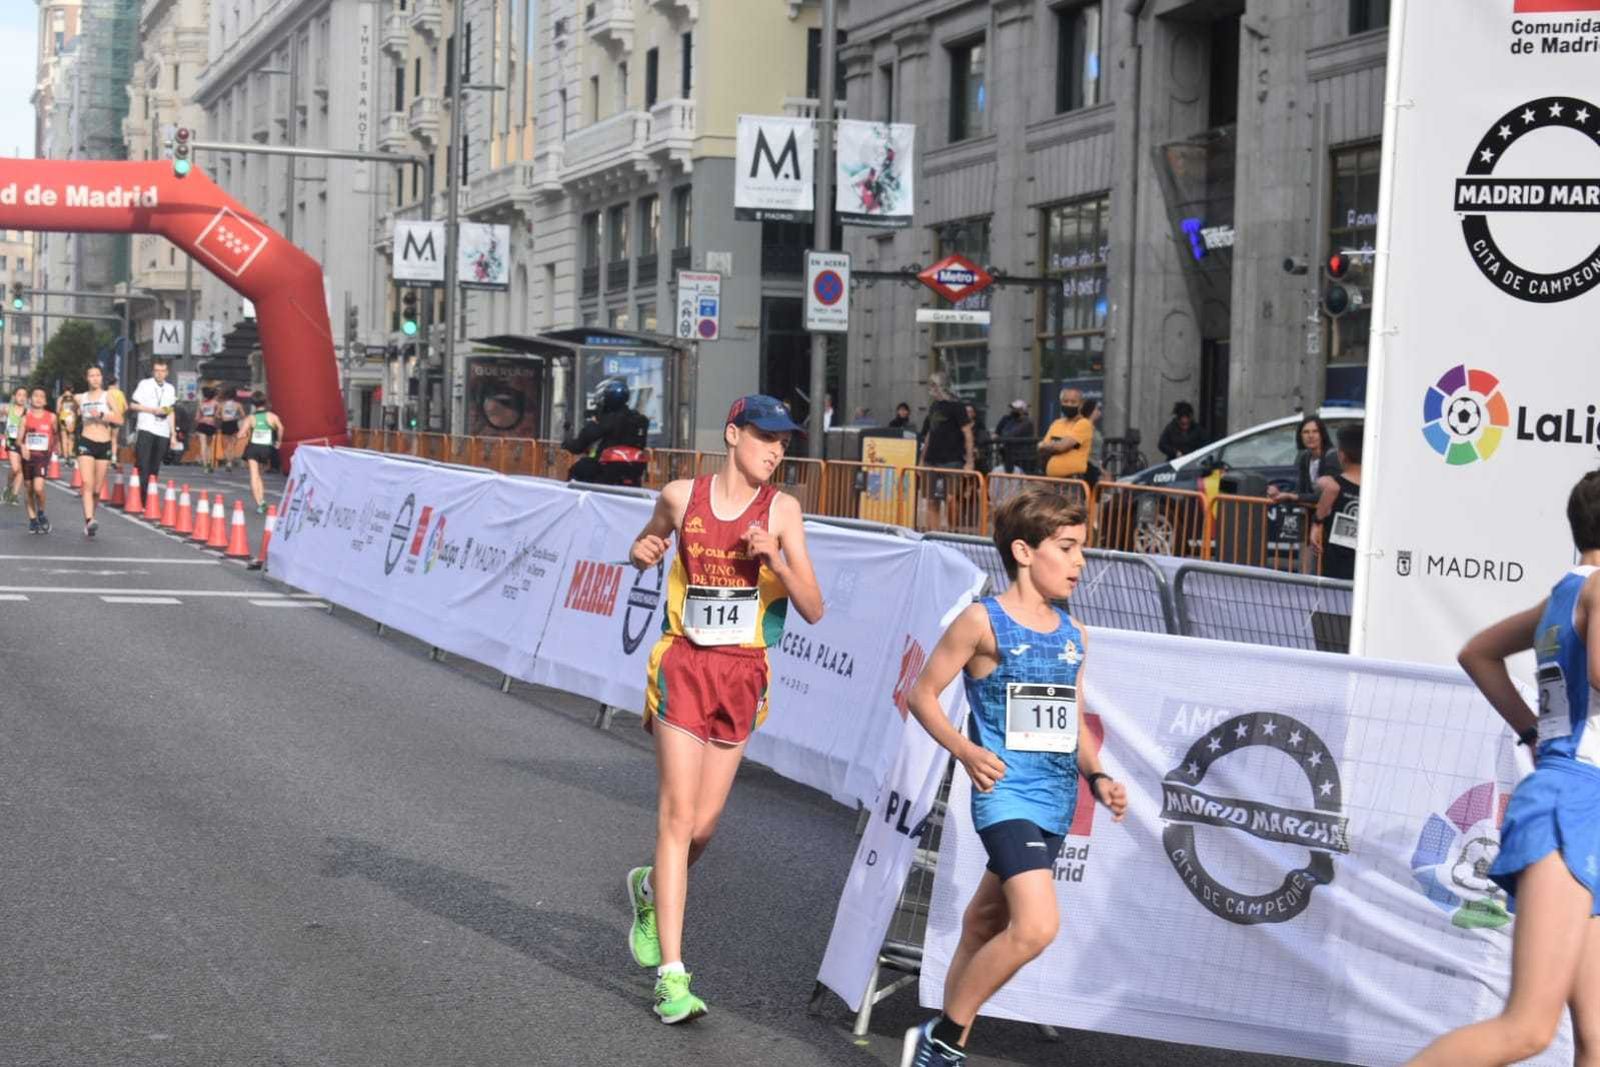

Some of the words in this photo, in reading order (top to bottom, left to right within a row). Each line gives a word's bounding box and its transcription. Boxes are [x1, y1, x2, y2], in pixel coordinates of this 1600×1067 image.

[1511, 18, 1600, 35] Comunida
[1511, 37, 1534, 54] de
[1541, 36, 1600, 54] Madri
[358, 112, 368, 162] HOTE
[24, 183, 58, 206] de
[66, 184, 158, 208] Madrid
[1458, 185, 1545, 205] MADRID
[1550, 185, 1600, 205] MAR
[939, 269, 974, 284] Metro
[1473, 239, 1500, 276] CITA
[1502, 269, 1524, 291] DE
[933, 313, 957, 321] Gran
[1517, 404, 1600, 452] LaLi
[692, 573, 708, 585] DE
[709, 575, 745, 588] TORO
[704, 563, 736, 577] VINO
[1427, 555, 1524, 583] MADRID
[564, 560, 624, 617] MARCA
[703, 605, 739, 626] 114
[815, 643, 854, 679] PLAZA
[1032, 704, 1067, 730] 118
[1166, 790, 1248, 825] MADRID
[1252, 809, 1346, 850] MARCHA
[1171, 848, 1200, 891] CITA
[1203, 885, 1221, 908] DE
